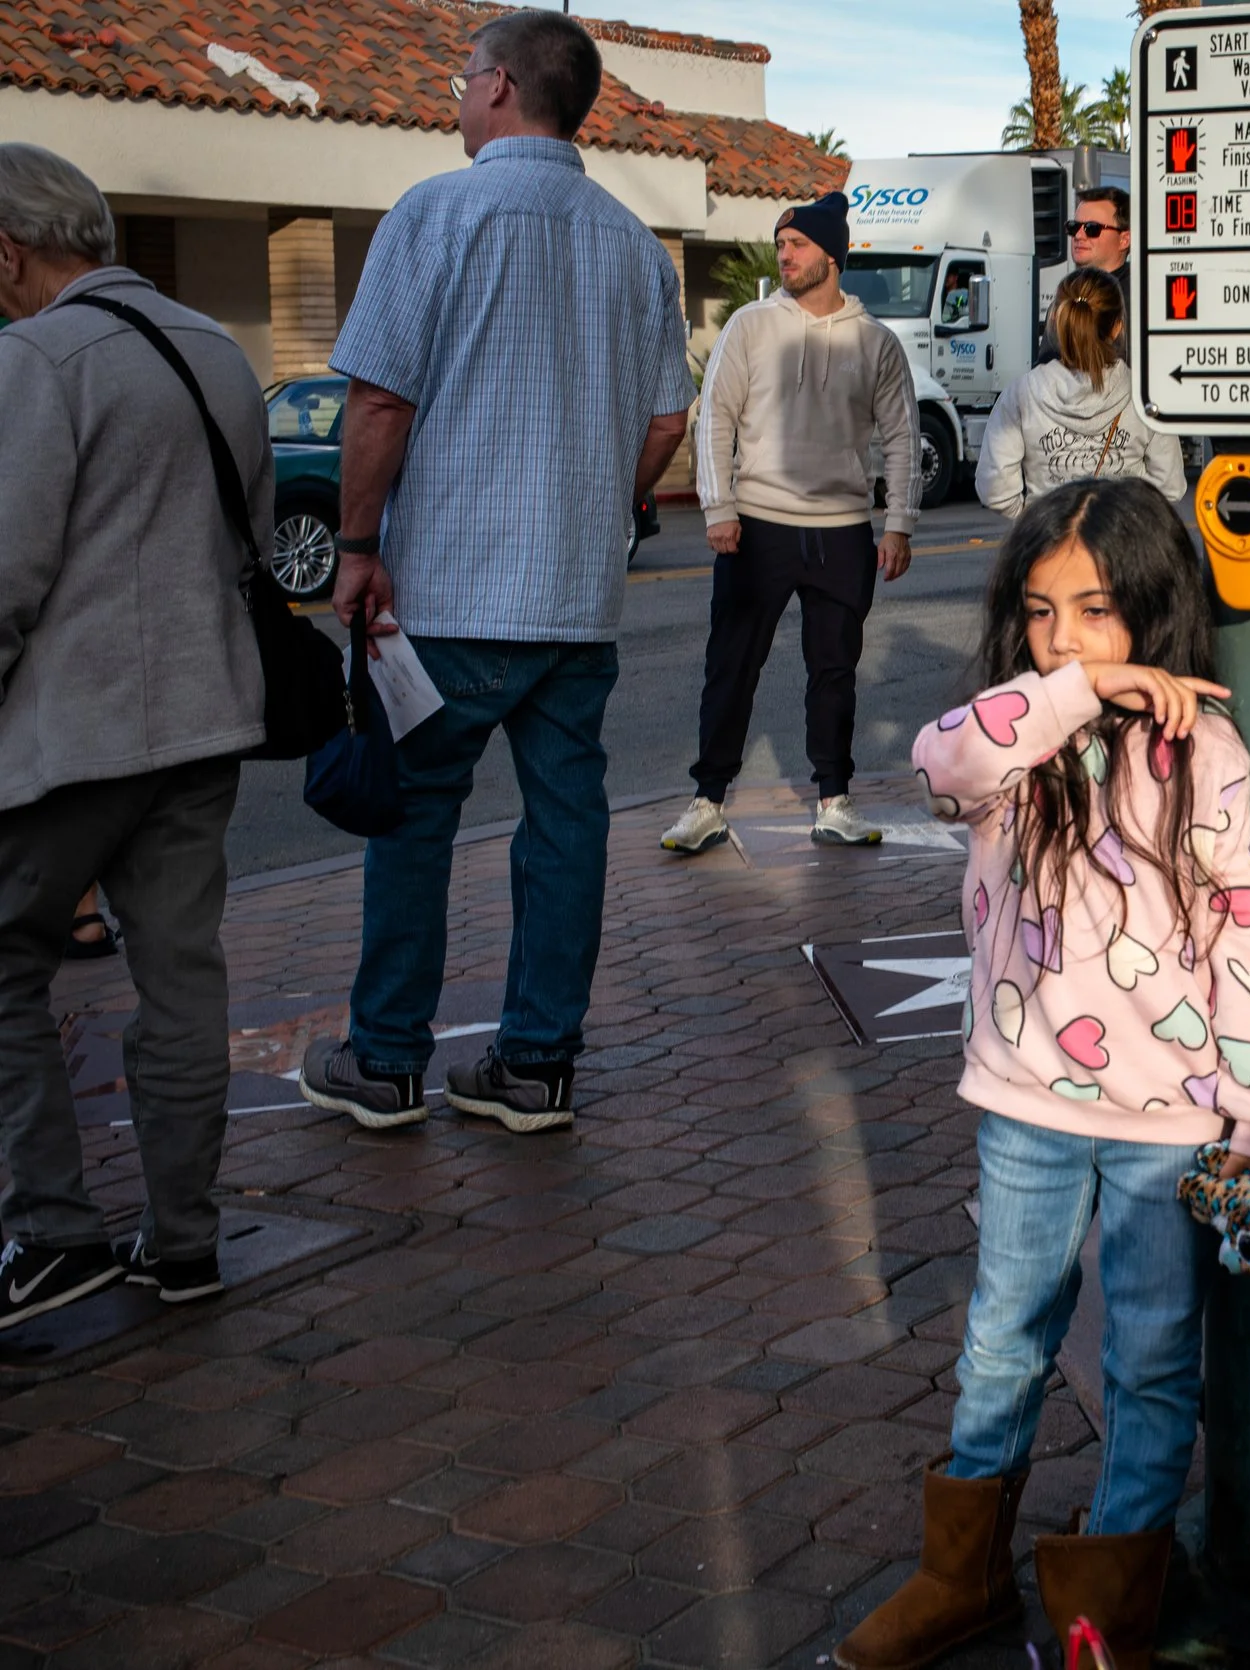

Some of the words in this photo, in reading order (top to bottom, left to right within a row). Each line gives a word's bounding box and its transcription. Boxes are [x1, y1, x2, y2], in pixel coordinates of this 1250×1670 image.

[1210, 31, 1249, 53] START
[1166, 175, 1198, 187] FLASHING
[1239, 169, 1250, 188] If
[876, 208, 890, 216] the
[890, 207, 912, 216] heart
[1211, 194, 1243, 214] TIME
[855, 216, 875, 225] food
[875, 216, 891, 225] and
[891, 216, 920, 225] service
[1210, 218, 1224, 238] To
[1171, 235, 1191, 245] TIMER
[1169, 261, 1194, 272] STEADY
[1186, 347, 1228, 366] PUSH
[1200, 384, 1220, 403] TO
